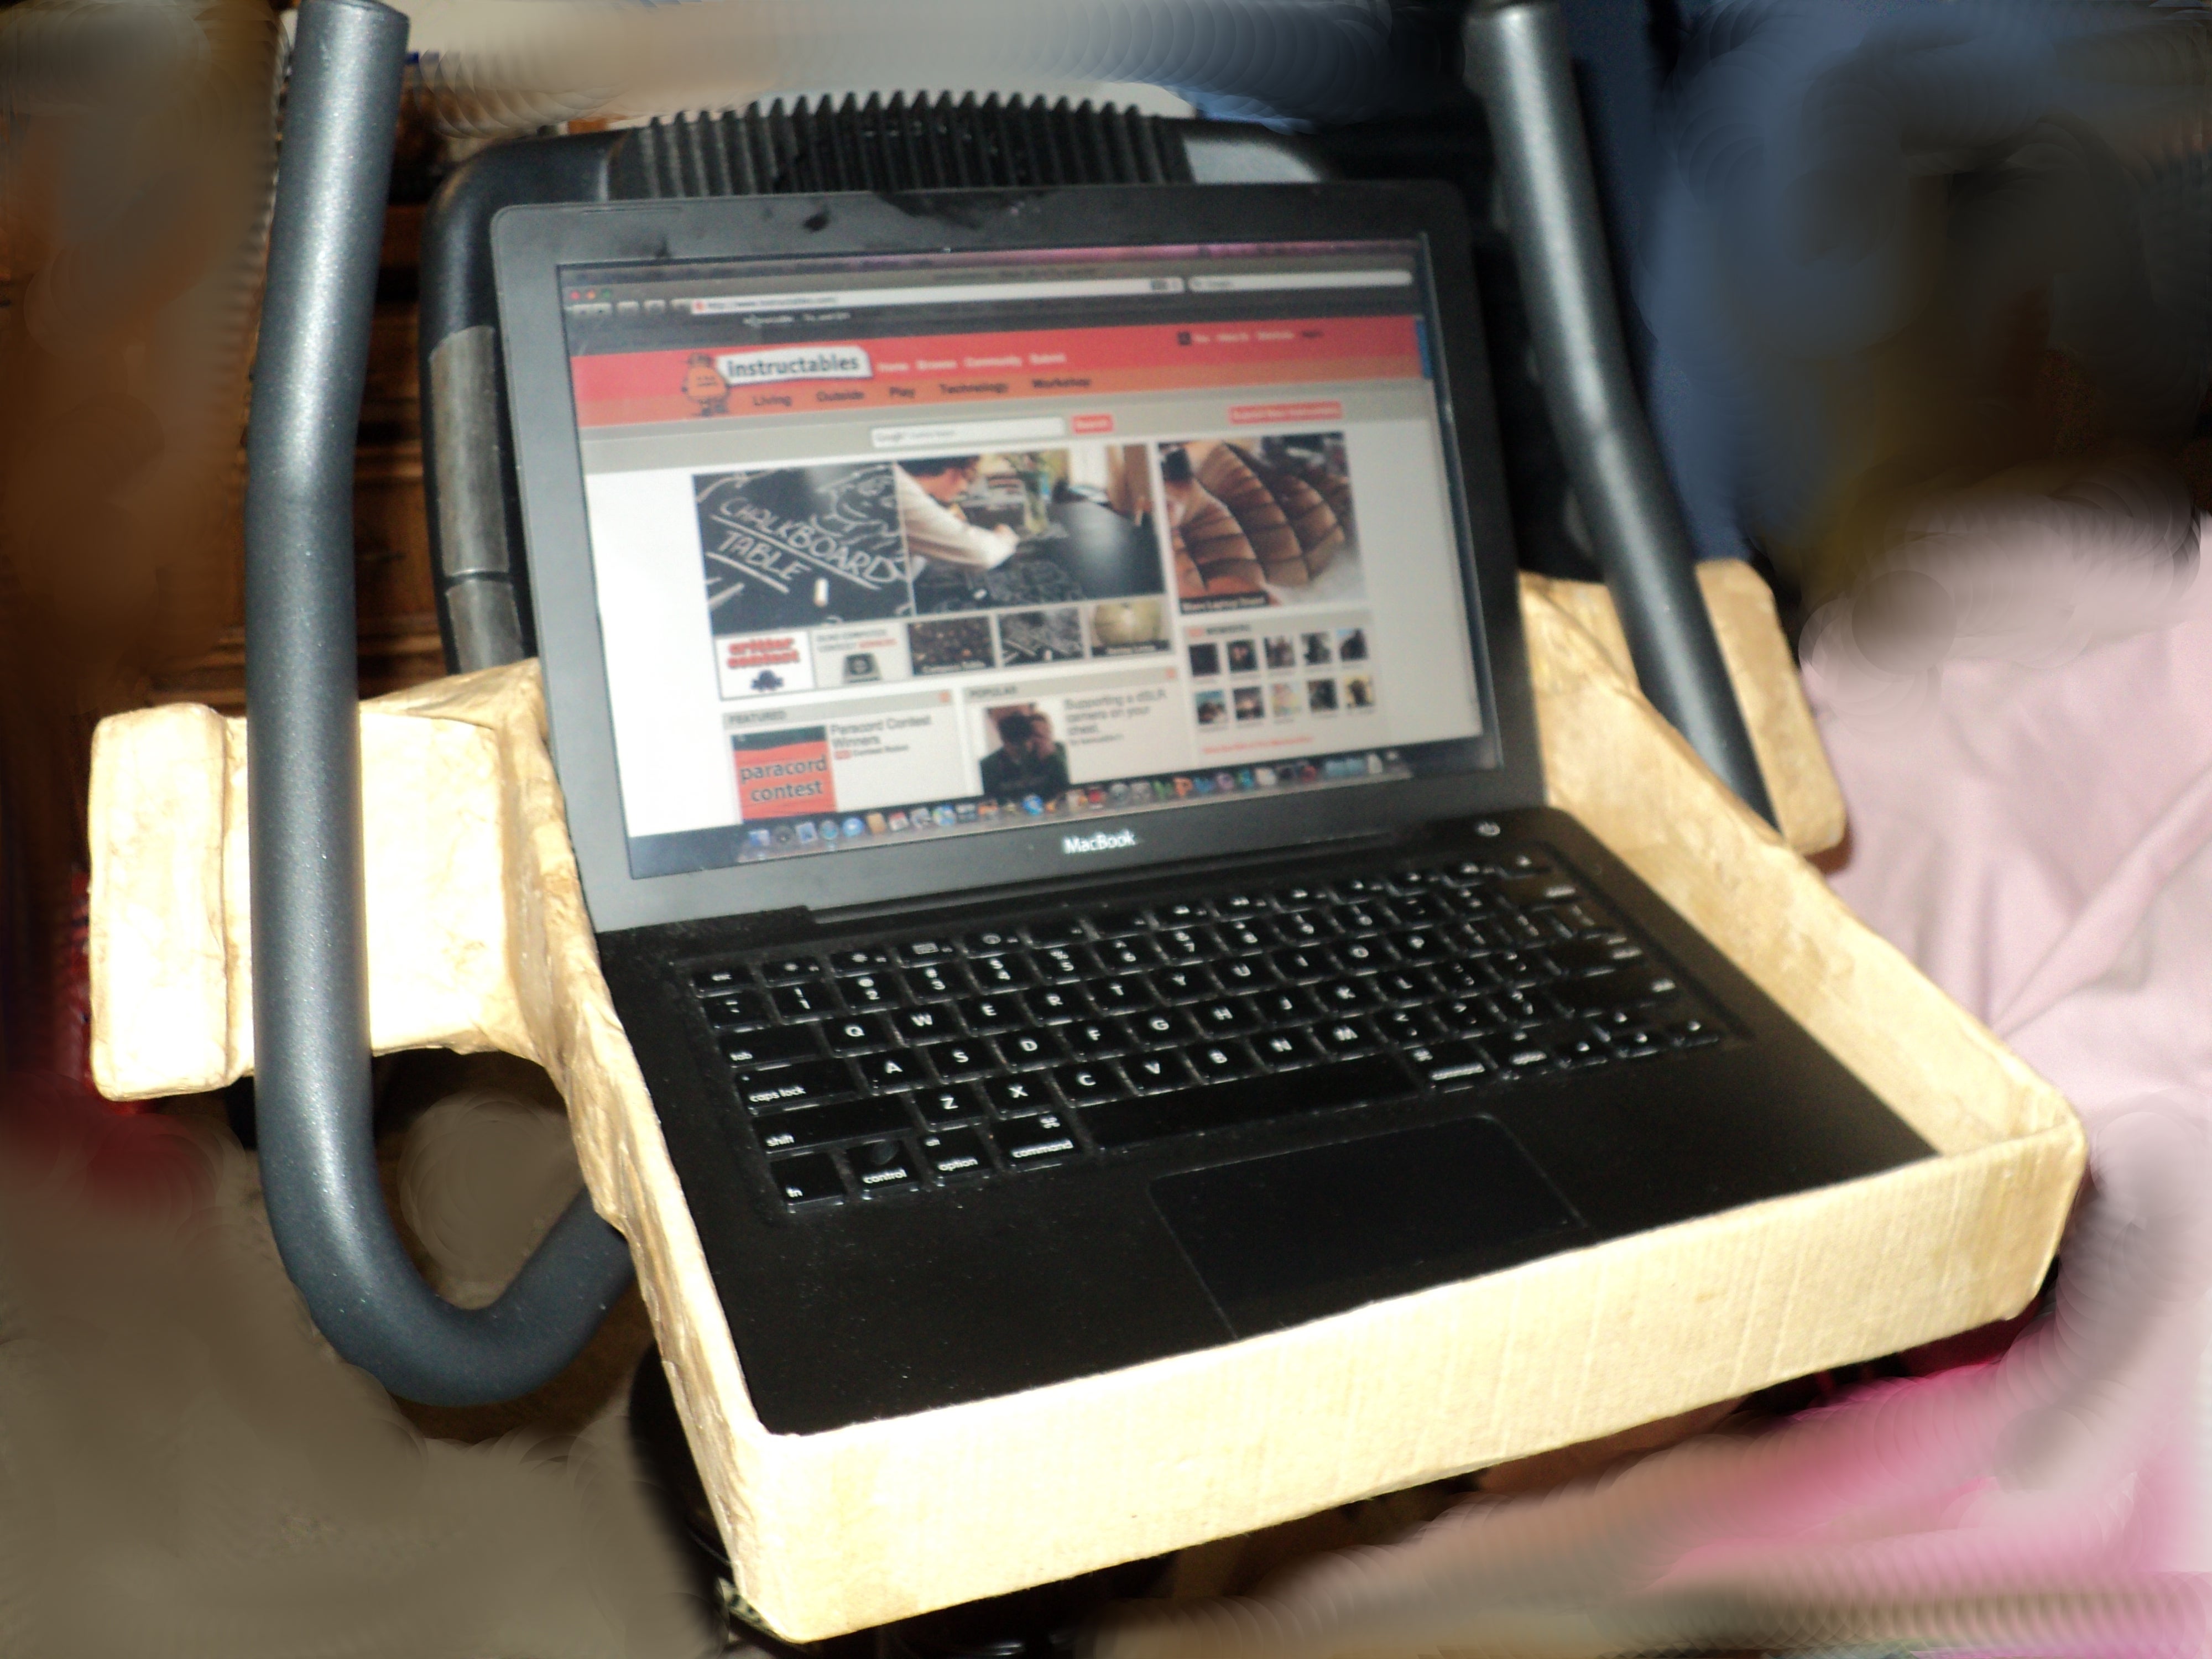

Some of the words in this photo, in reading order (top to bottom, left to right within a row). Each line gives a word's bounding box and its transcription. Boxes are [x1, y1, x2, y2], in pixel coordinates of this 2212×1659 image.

[753, 395, 792, 407] Living
[816, 390, 864, 401] Outside
[889, 387, 915, 399] Play
[940, 383, 1008, 394] Technology
[720, 497, 897, 583] CHALKBOARD
[719, 530, 812, 581] TABLE
[740, 754, 827, 784] paracord
[751, 780, 823, 802] contest
[1062, 830, 1136, 854] MacBook
[1350, 946, 1369, 958] O
[1233, 964, 1251, 977] U
[1110, 984, 1124, 996] T
[799, 999, 811, 1009] 1
[1046, 994, 1063, 1006] R
[982, 1004, 997, 1016] E
[1213, 1007, 1233, 1020] H
[911, 1014, 933, 1027] W
[1150, 1018, 1170, 1031] G
[844, 1025, 865, 1037] Q
[1087, 1029, 1100, 1041] F
[1020, 1039, 1038, 1052] D
[1271, 1039, 1292, 1052] N
[953, 1050, 969, 1063] S
[1209, 1051, 1228, 1064] B
[885, 1061, 903, 1074] A
[1144, 1062, 1161, 1074] V
[1077, 1073, 1096, 1086] C
[749, 1091, 779, 1102] caps
[777, 1086, 806, 1098] lock
[1008, 1085, 1029, 1098] X
[940, 1095, 958, 1110] Z
[1011, 1139, 1074, 1158] command
[937, 1157, 978, 1171] option
[862, 1168, 907, 1184] control
[786, 1187, 803, 1198] fn
